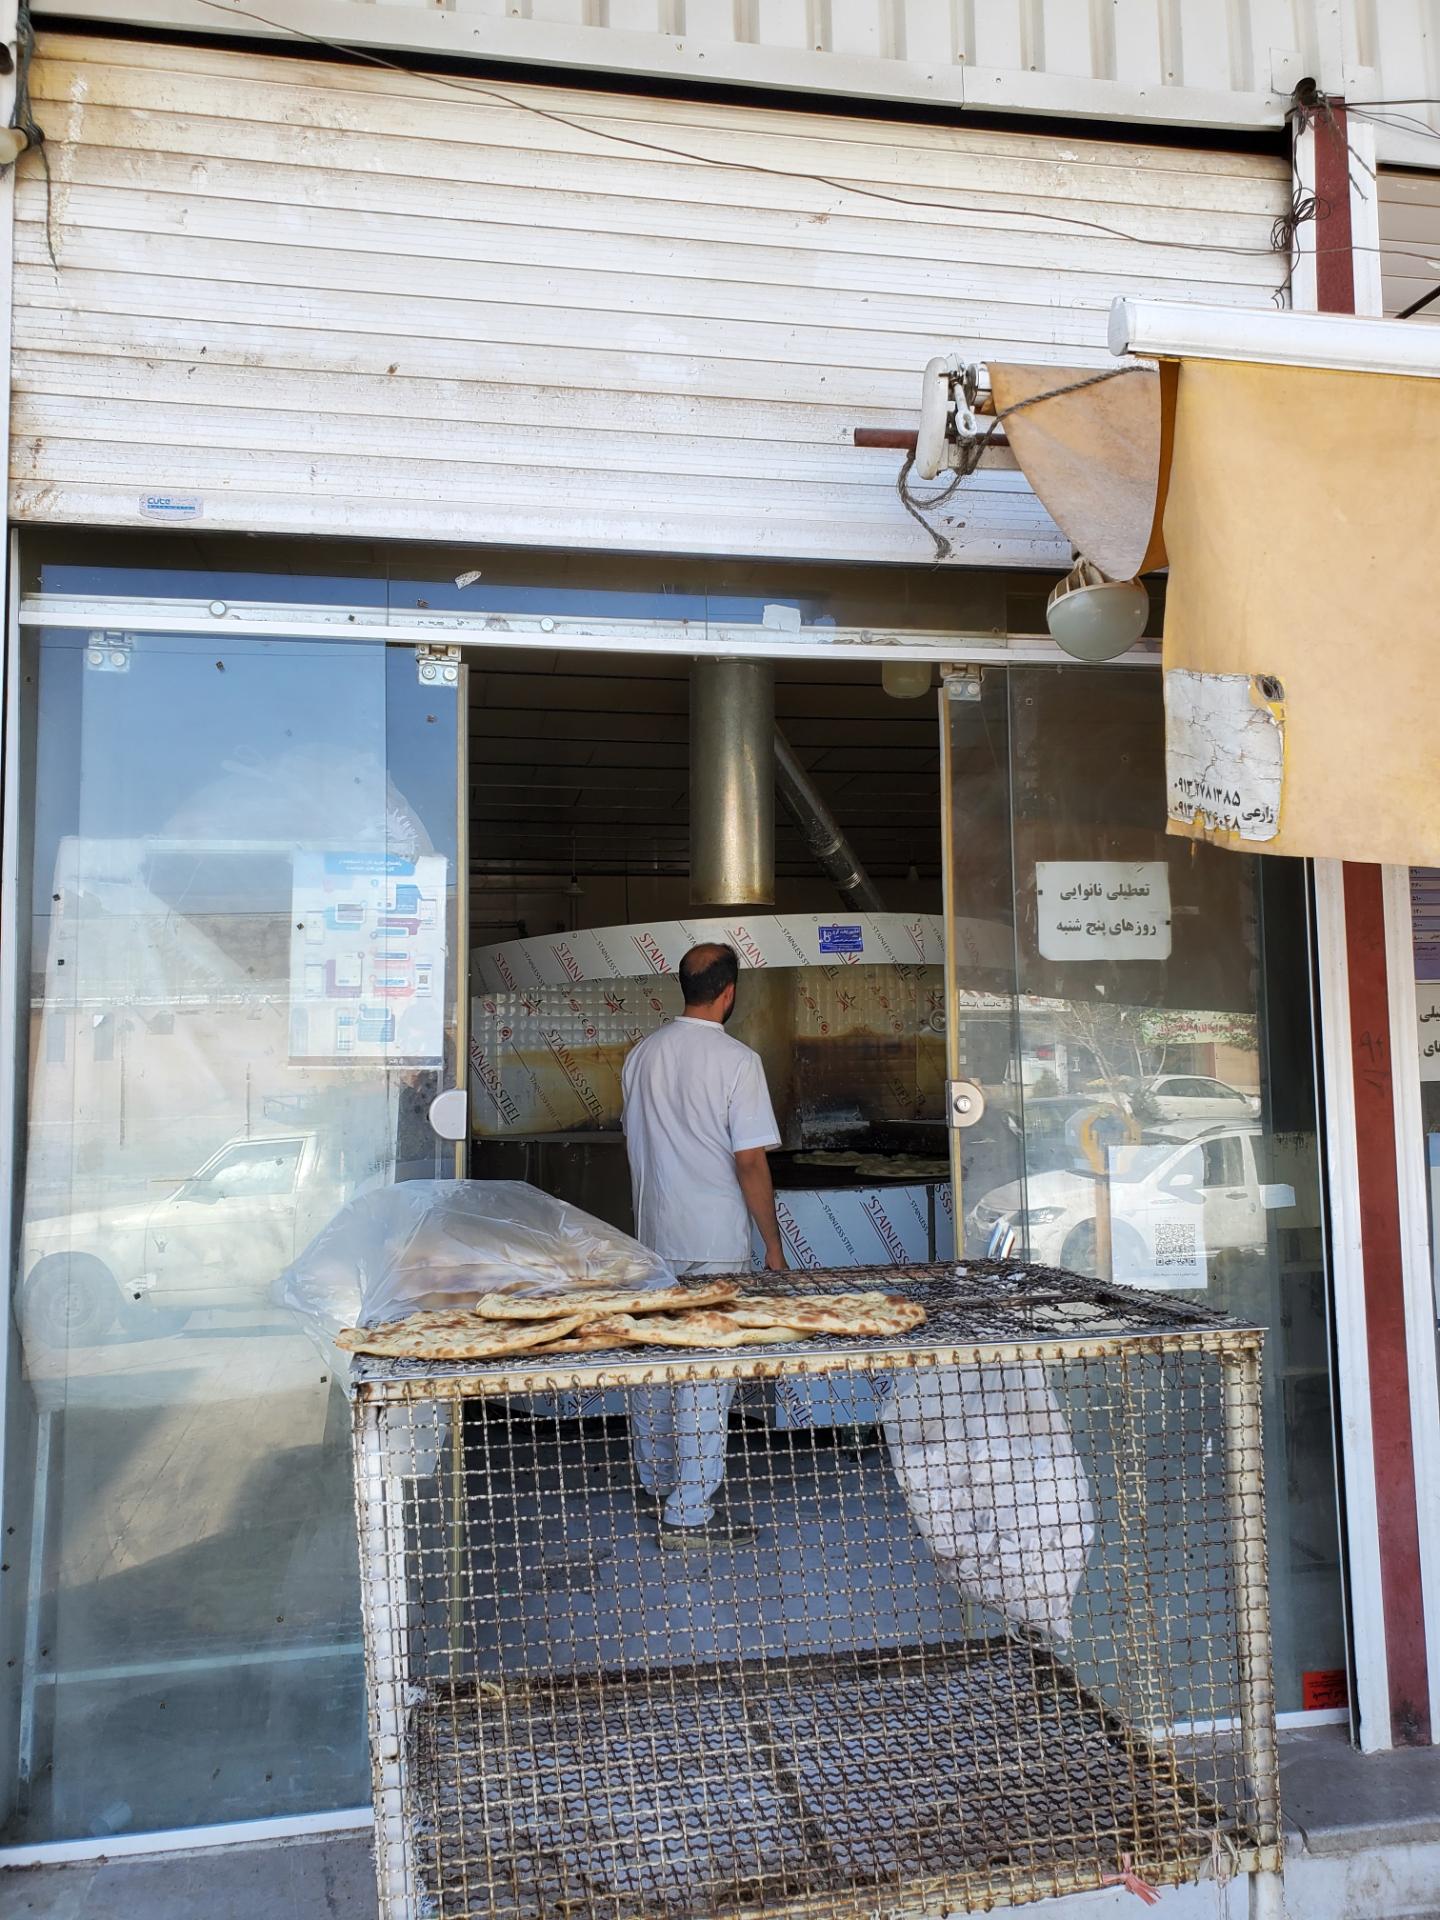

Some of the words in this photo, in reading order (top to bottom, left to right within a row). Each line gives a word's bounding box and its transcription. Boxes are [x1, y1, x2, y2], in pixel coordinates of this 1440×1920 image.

[1242, 805, 1273, 823] زارعی
[1060, 883, 1102, 900] نانوایی
[1106, 883, 1150, 900] تعطیلی
[1056, 918, 1082, 935] شنبه
[1086, 920, 1106, 936] پنج
[1109, 918, 1157, 936] روزهای
[470, 1038, 502, 1091] TAINLESS
[495, 1089, 520, 1124] STEEL
[548, 1029, 588, 1088] STAINLESS
[581, 1086, 604, 1119] STEEL
[823, 1205, 846, 1238] STAINLESS
